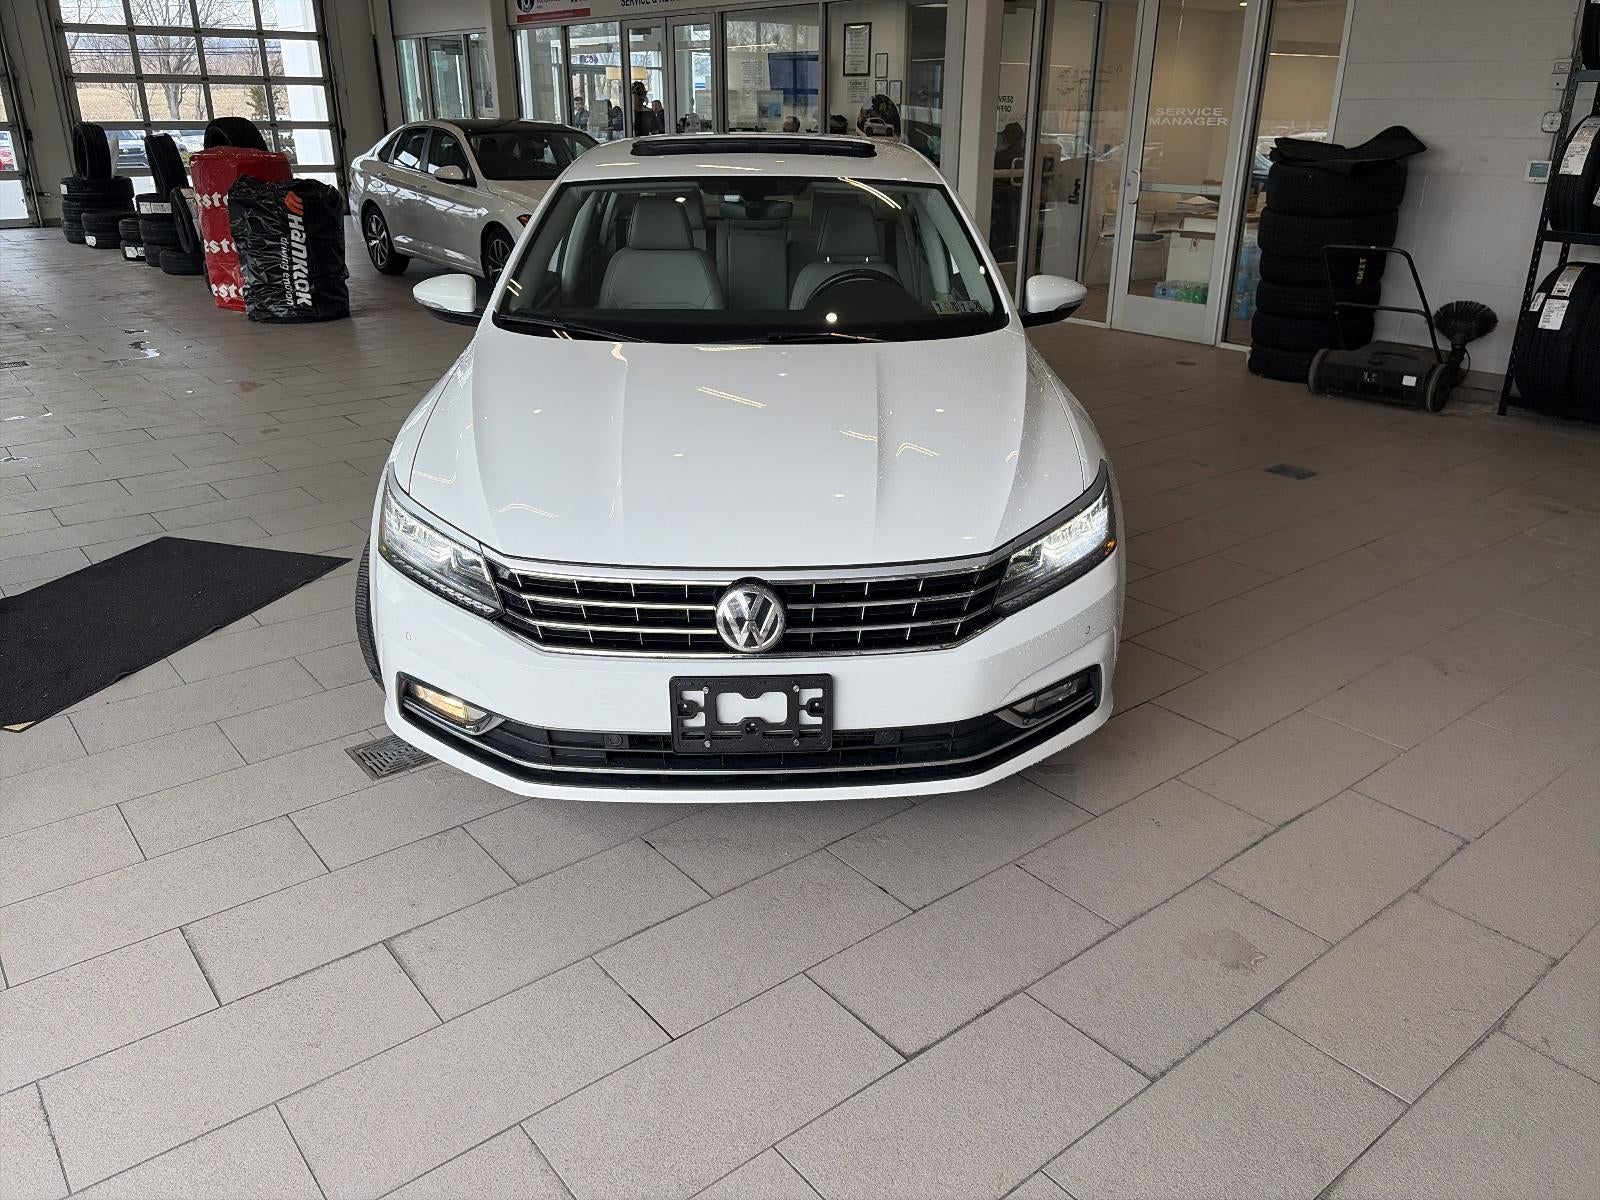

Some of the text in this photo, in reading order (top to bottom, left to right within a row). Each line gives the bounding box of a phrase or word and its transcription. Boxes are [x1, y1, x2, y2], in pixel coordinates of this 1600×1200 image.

[1155, 107, 1223, 116] SERVICE
[1149, 117, 1228, 126] MANAGER
[280, 237, 290, 271] driving
